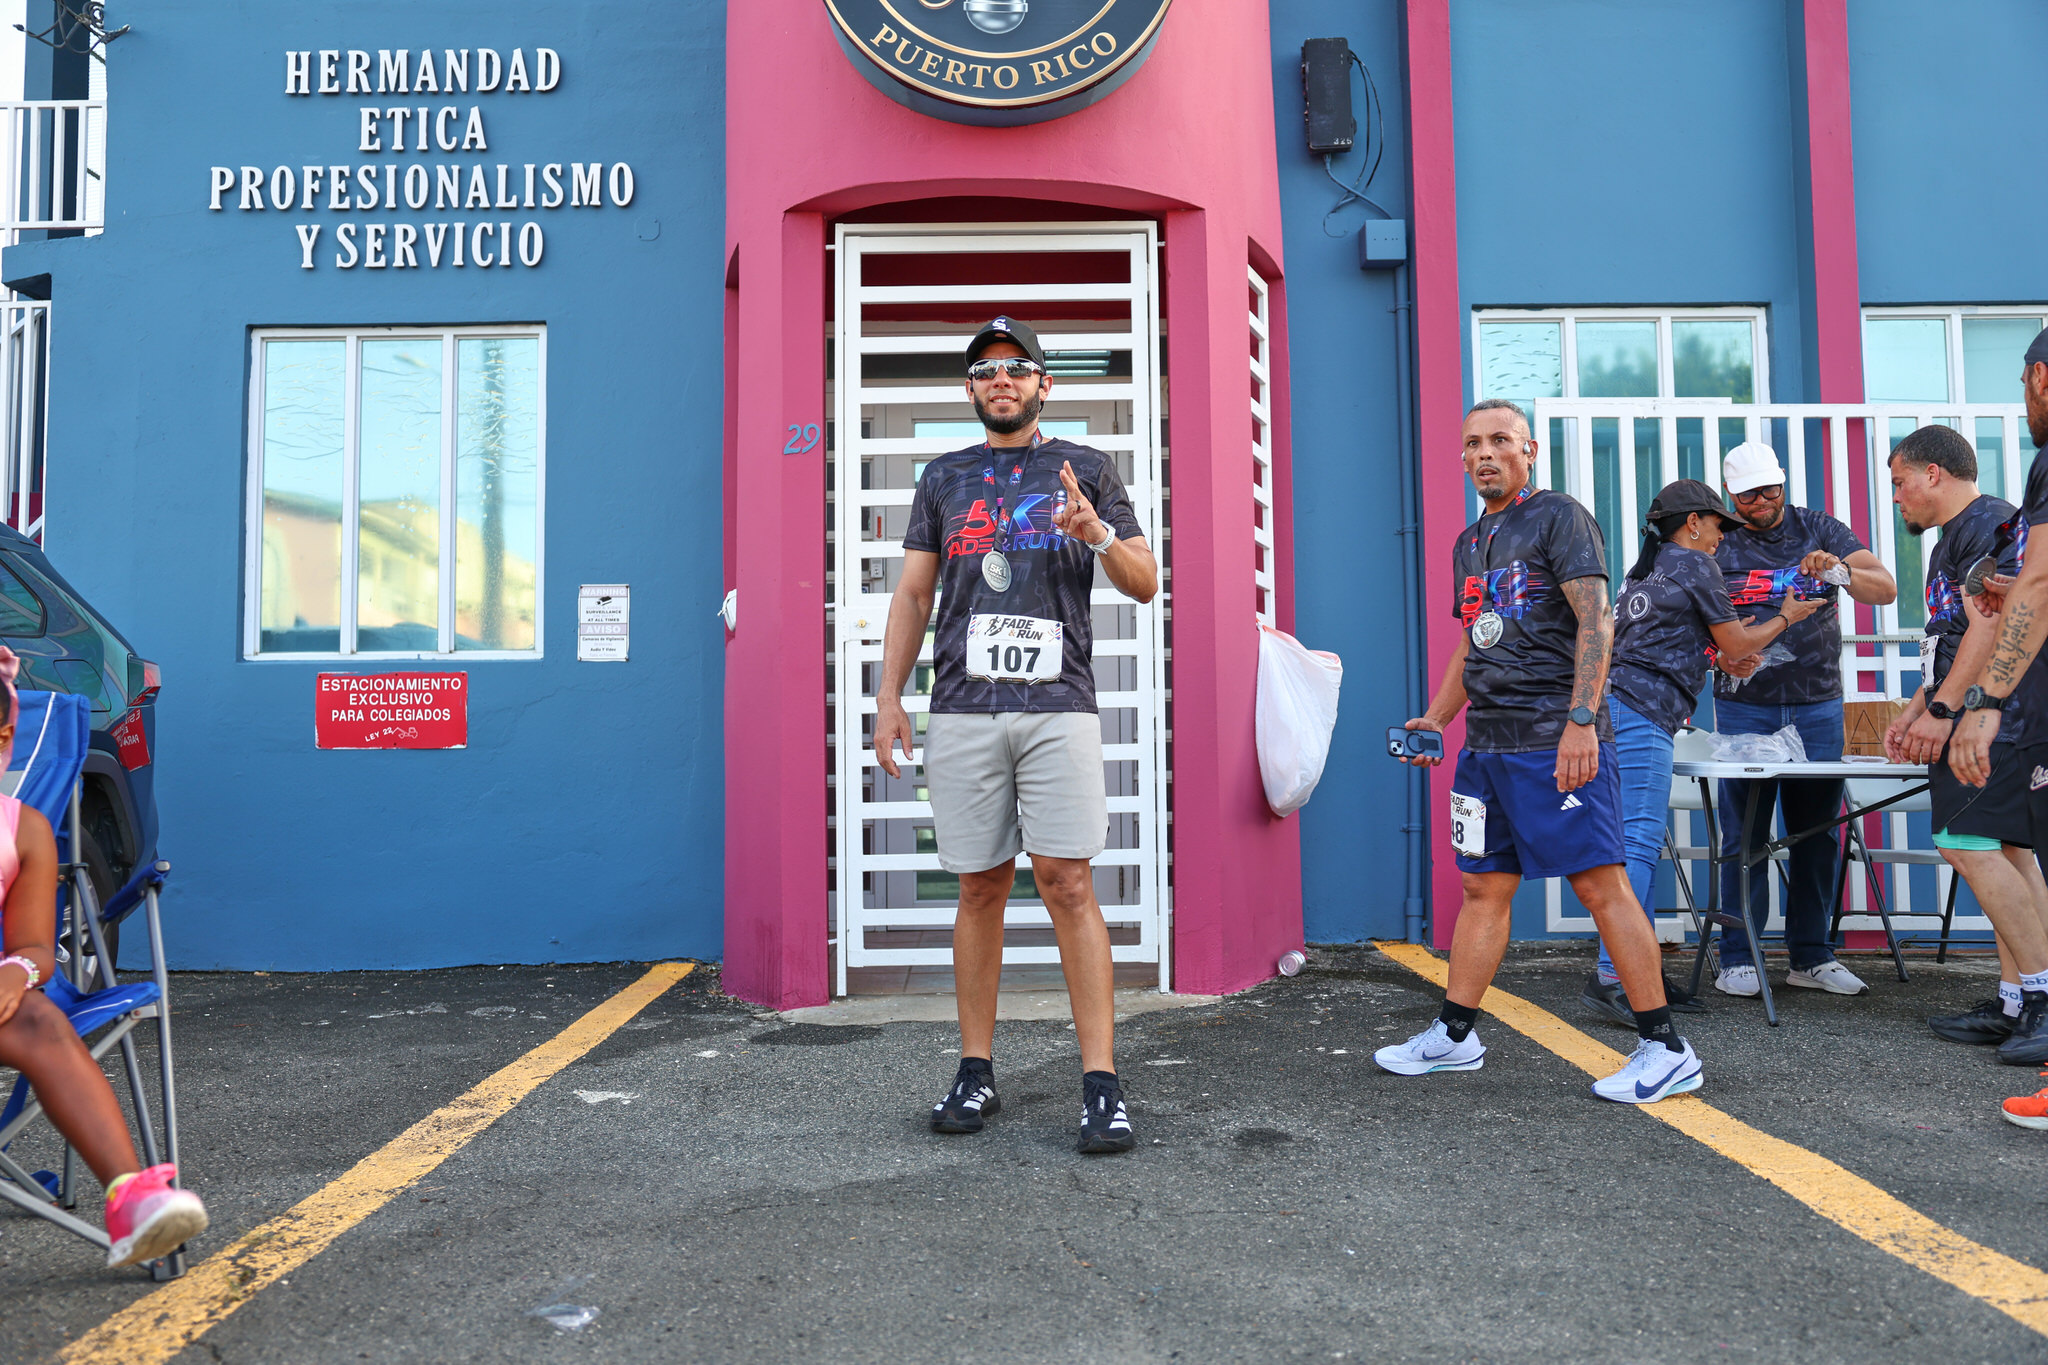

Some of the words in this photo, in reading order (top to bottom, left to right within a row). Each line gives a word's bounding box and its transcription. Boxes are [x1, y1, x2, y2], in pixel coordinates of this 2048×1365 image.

[870, 23, 1019, 89] PUERTO
[1030, 31, 1117, 85] RICO
[285, 48, 561, 94] HERMANDAD
[359, 106, 487, 151] ETICA
[209, 162, 634, 210] PROFESIONALISMO
[296, 225, 320, 268] Y
[336, 222, 544, 268] SERVICIO
[784, 424, 820, 454] 29
[948, 538, 995, 559] ADE
[1013, 533, 1061, 551] RUN
[1741, 565, 1802, 595] 5K
[582, 588, 626, 596] WARNING
[586, 625, 621, 634] AVISO
[1001, 618, 1034, 629] FADE
[1016, 630, 1044, 640] RUN
[987, 645, 1041, 673] 107
[322, 678, 461, 691] ESTACIONAMIENTO
[349, 693, 433, 705] EXCLUSIVO
[331, 710, 364, 721] PARA
[370, 709, 451, 721] COLEGIADOS
[365, 731, 379, 742] LEY
[382, 727, 392, 735] 22
[1456, 806, 1472, 817] RUN
